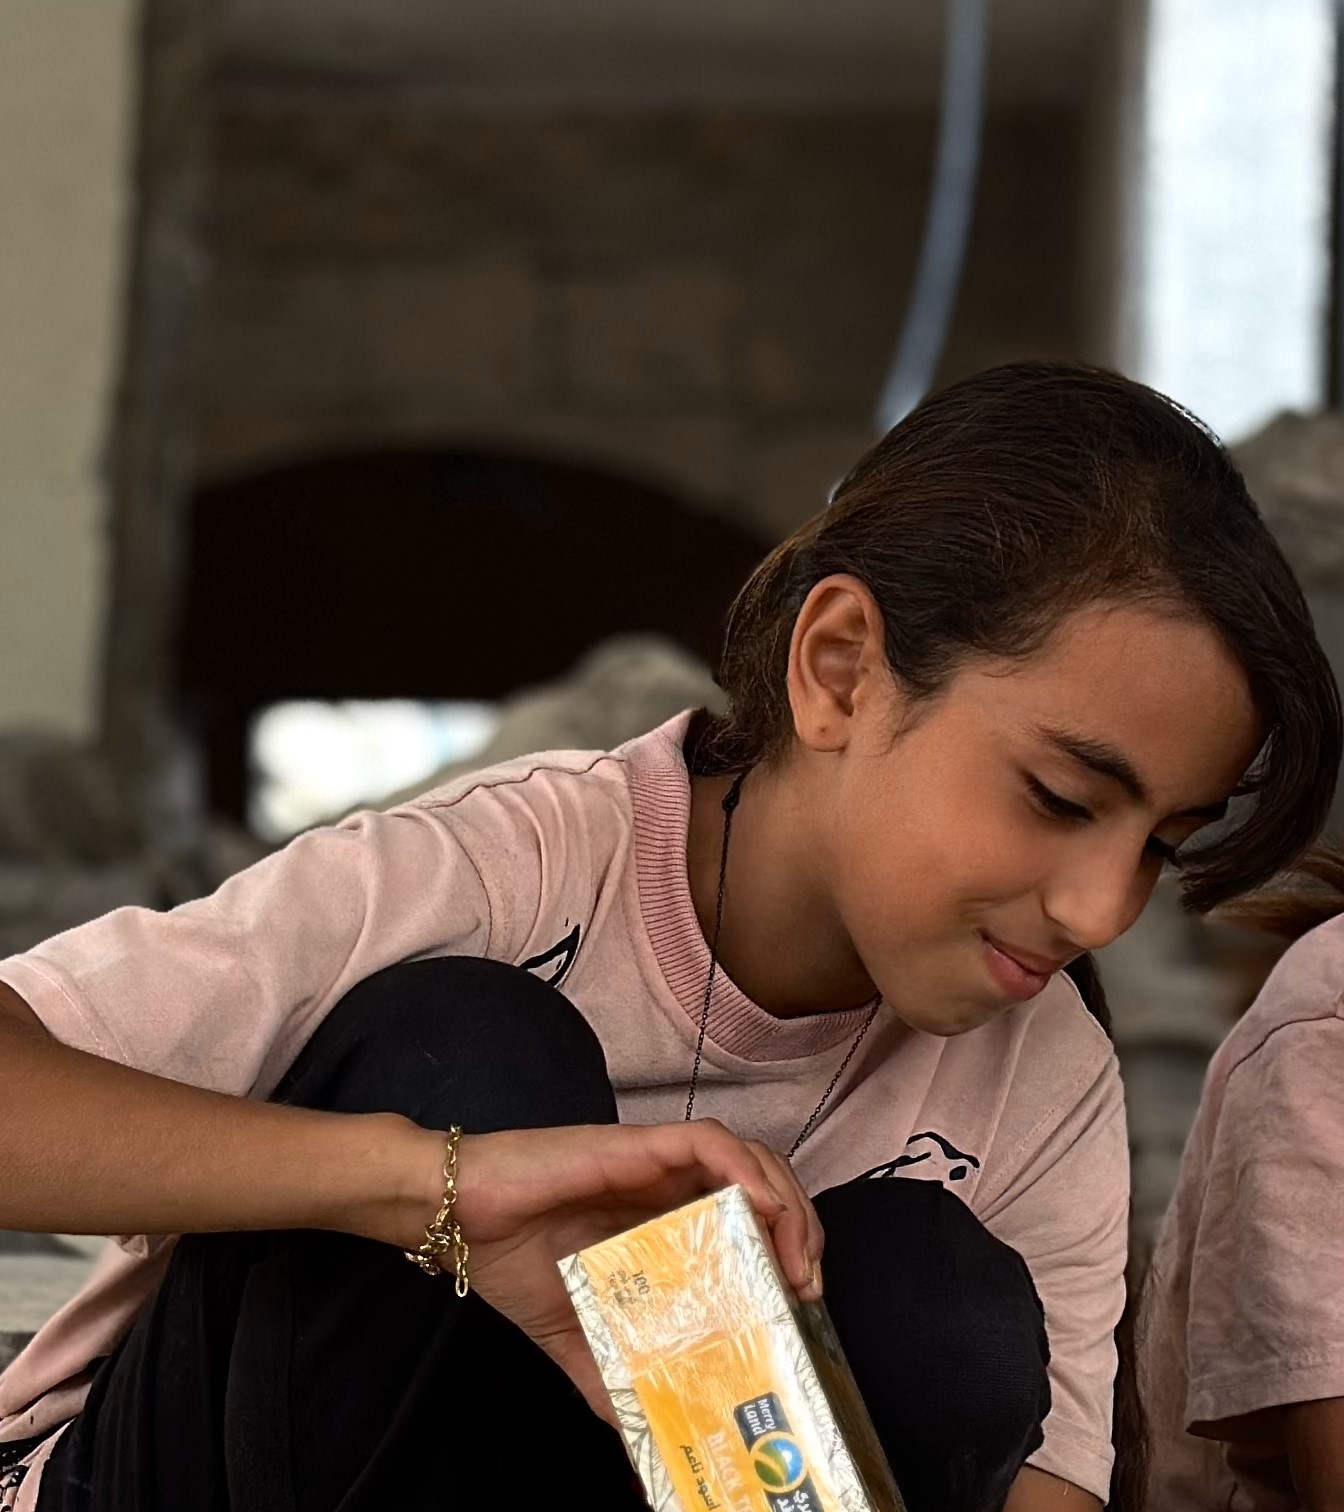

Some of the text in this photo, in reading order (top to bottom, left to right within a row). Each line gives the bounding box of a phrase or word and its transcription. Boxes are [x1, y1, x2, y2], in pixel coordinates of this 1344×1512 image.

[743, 1403, 766, 1435] Land
[757, 1398, 776, 1430] Merry
[707, 1431, 743, 1492] BLACK
